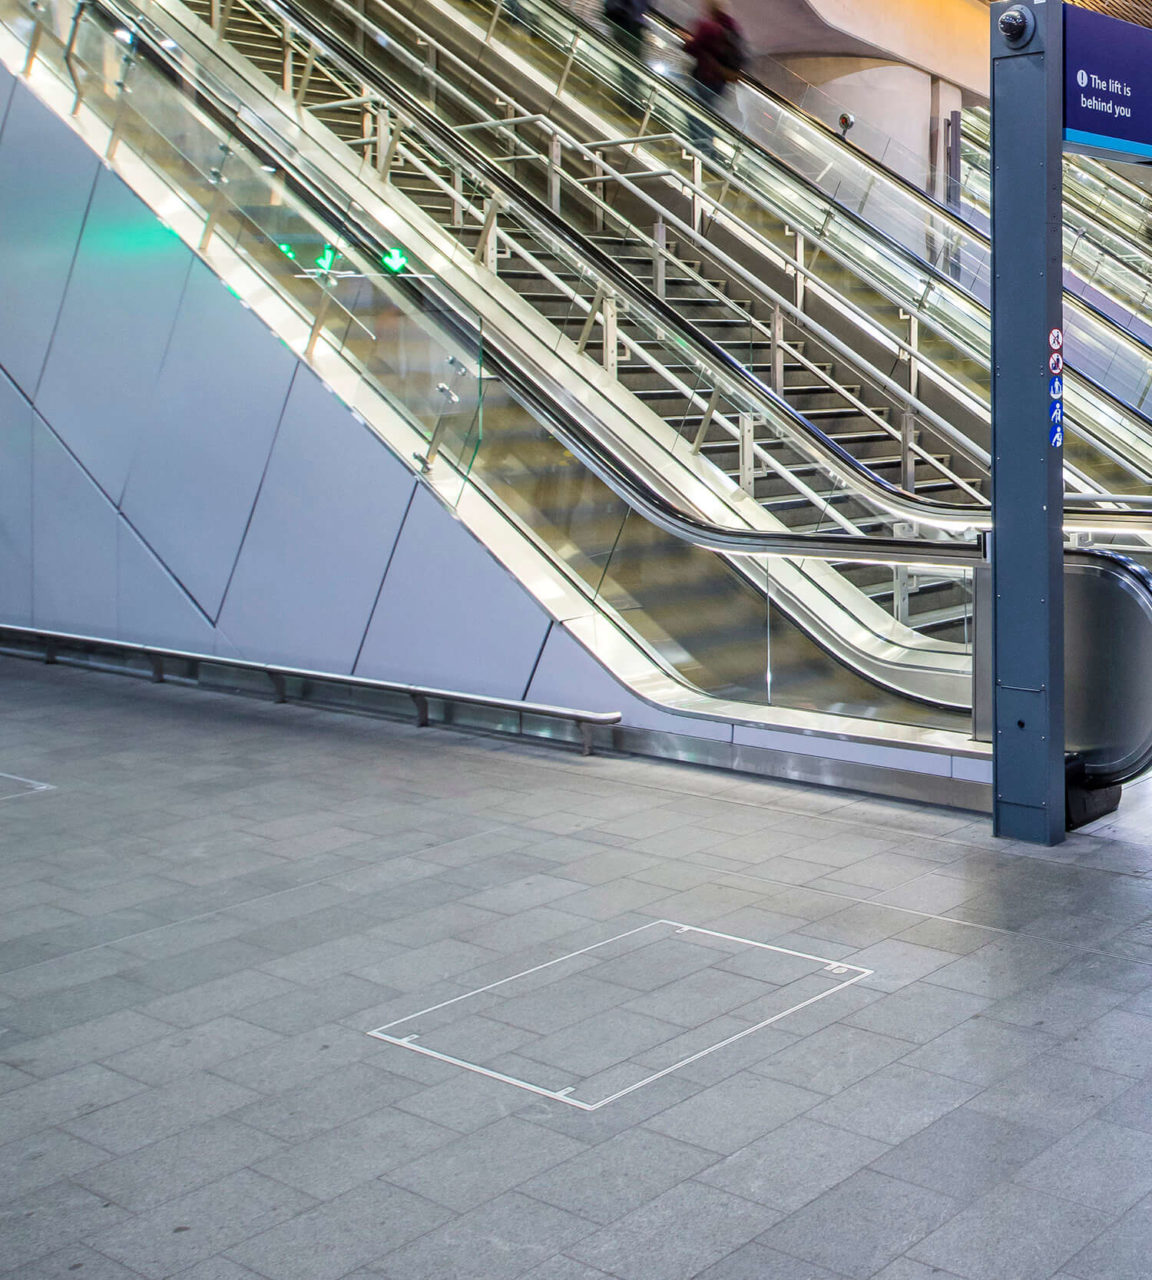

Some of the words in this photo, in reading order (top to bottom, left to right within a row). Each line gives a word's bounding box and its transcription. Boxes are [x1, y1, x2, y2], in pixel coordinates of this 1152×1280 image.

[1090, 74, 1107, 91] The
[1109, 78, 1122, 95] lift
[1123, 83, 1131, 96] is
[1081, 93, 1113, 113] behind
[1114, 105, 1131, 118] you
